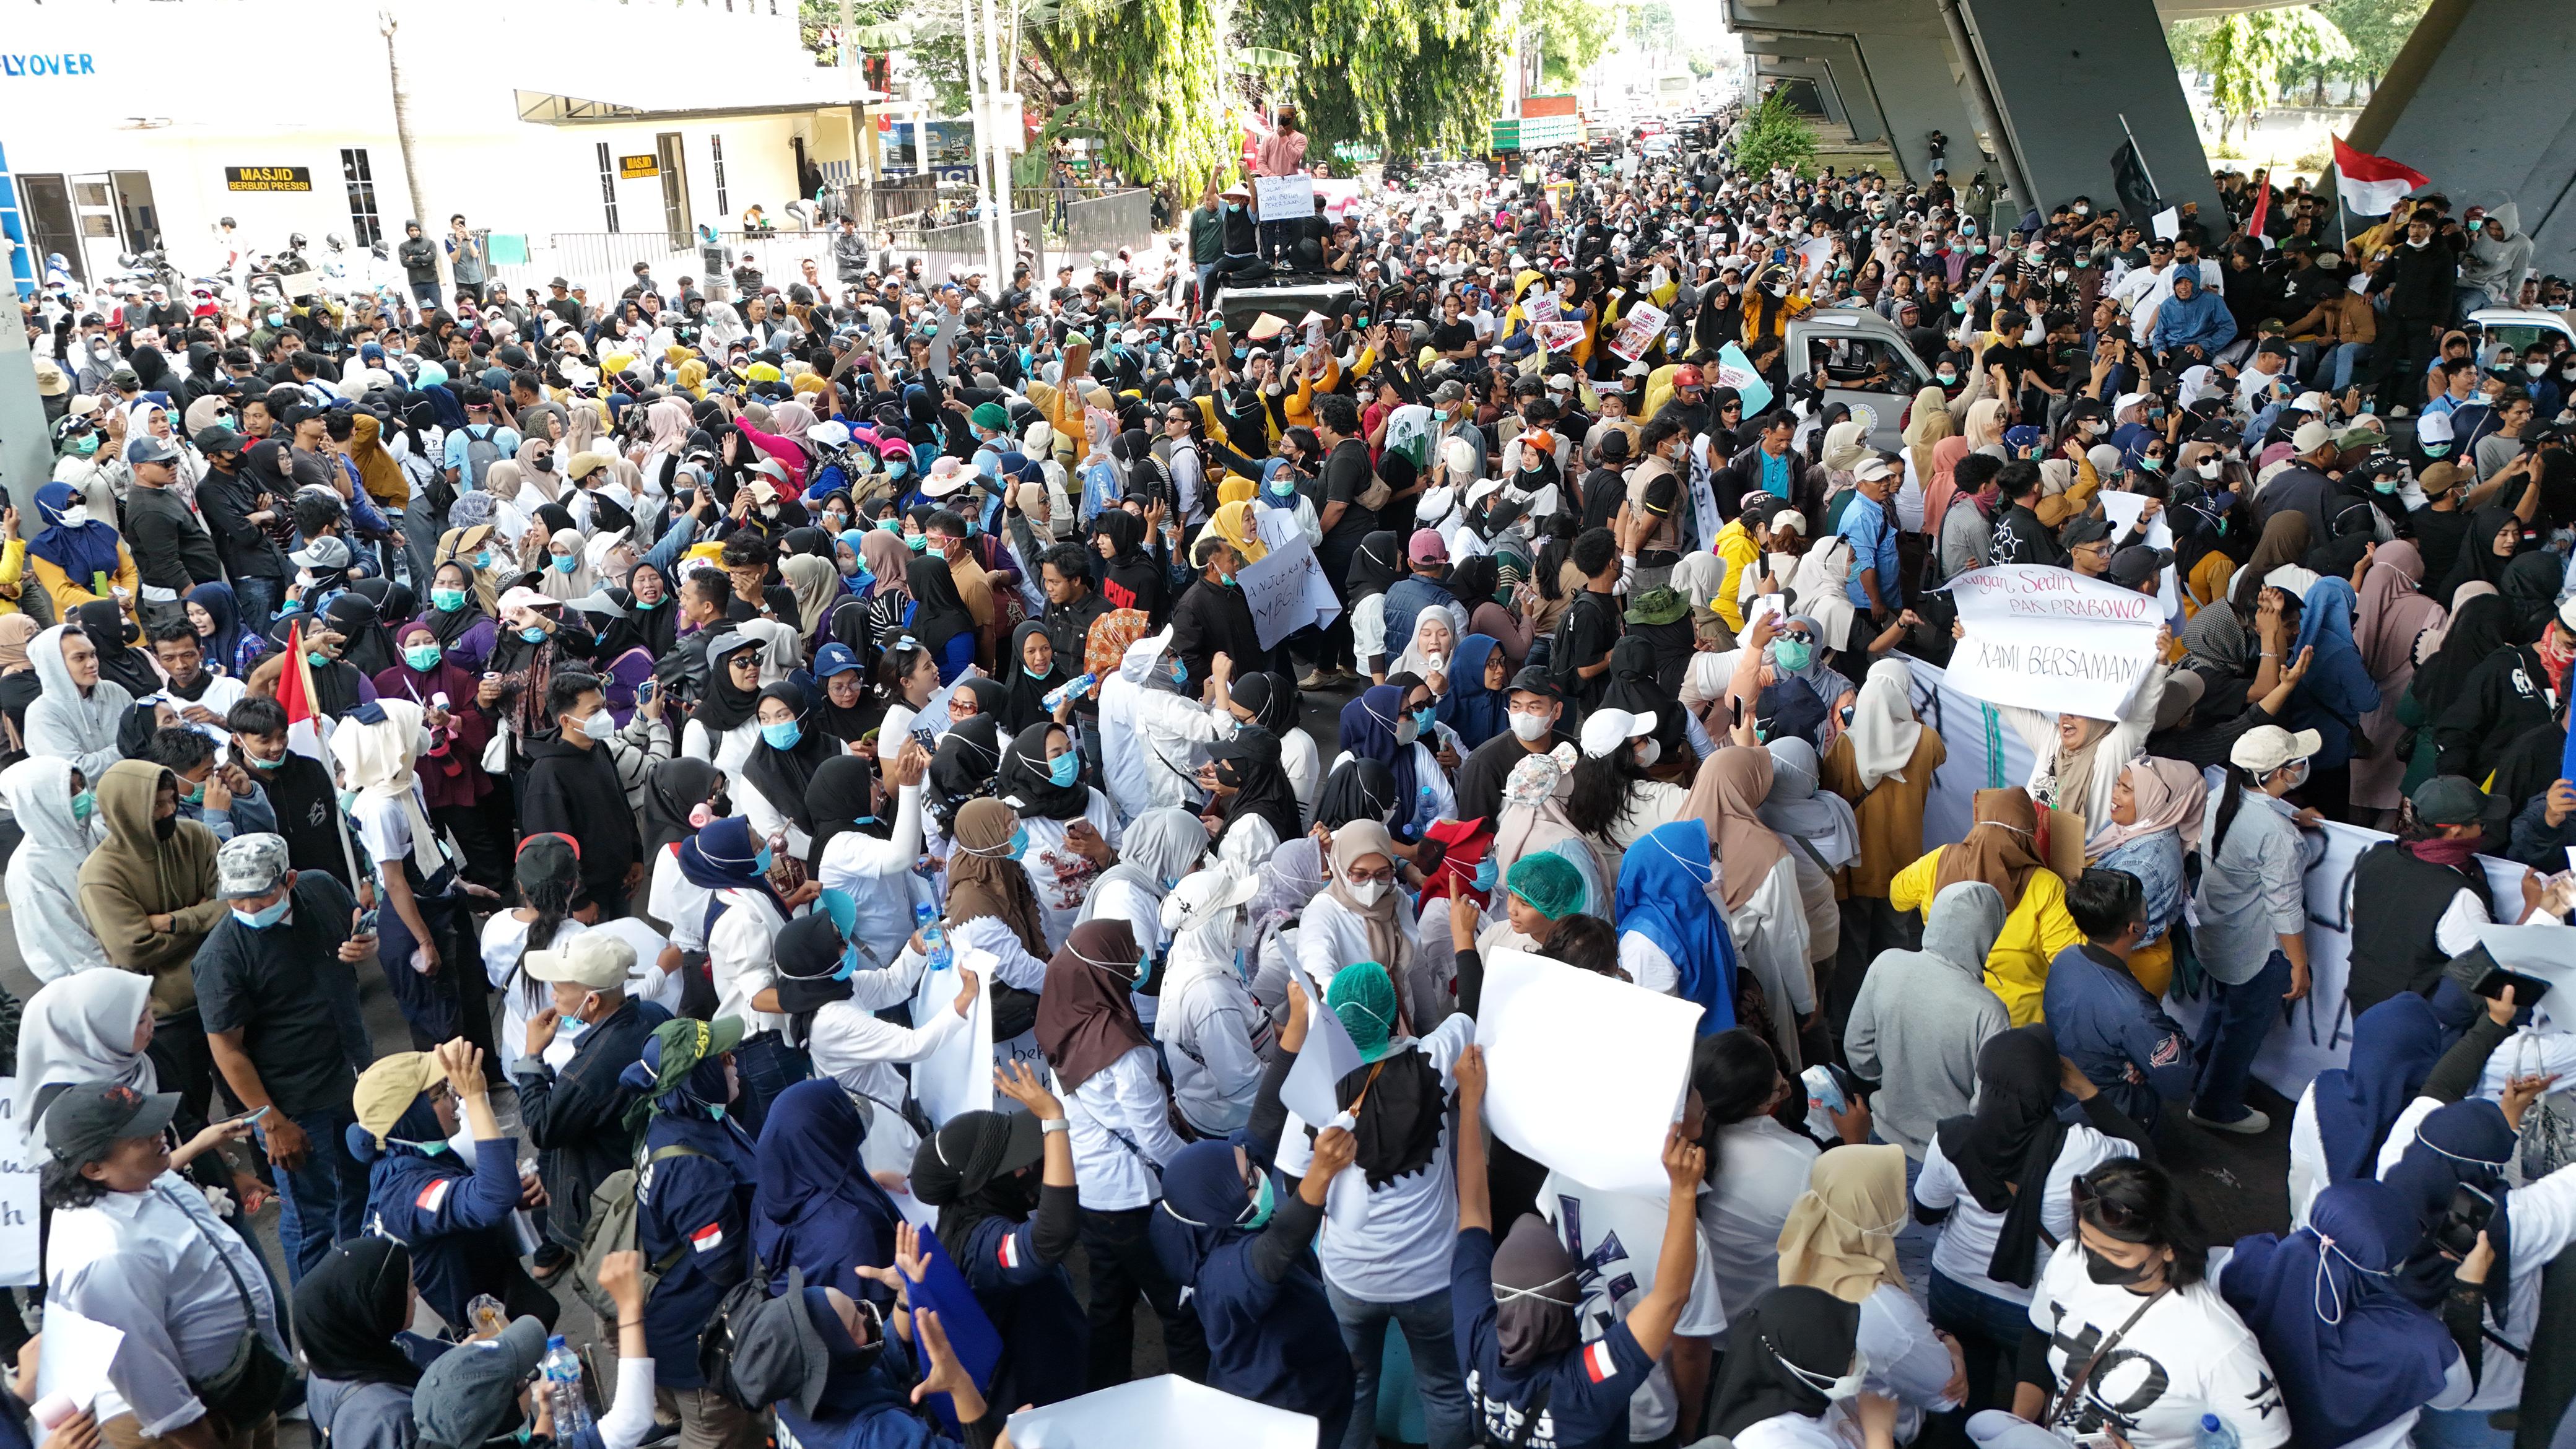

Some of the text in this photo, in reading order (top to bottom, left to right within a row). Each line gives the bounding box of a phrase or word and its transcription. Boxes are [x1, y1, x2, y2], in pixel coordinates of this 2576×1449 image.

[0, 54, 95, 76] LYOVER
[240, 168, 293, 181] MASJID
[229, 181, 308, 190] BERBUDI PRESISI
[1533, 299, 1551, 311] MBG
[1637, 309, 1656, 323] MBG
[1630, 322, 1651, 337] ndonesia
[1635, 320, 1648, 329] anak
[2019, 570, 2082, 593] Sedih
[2009, 598, 2146, 619] PAK PRABOWO
